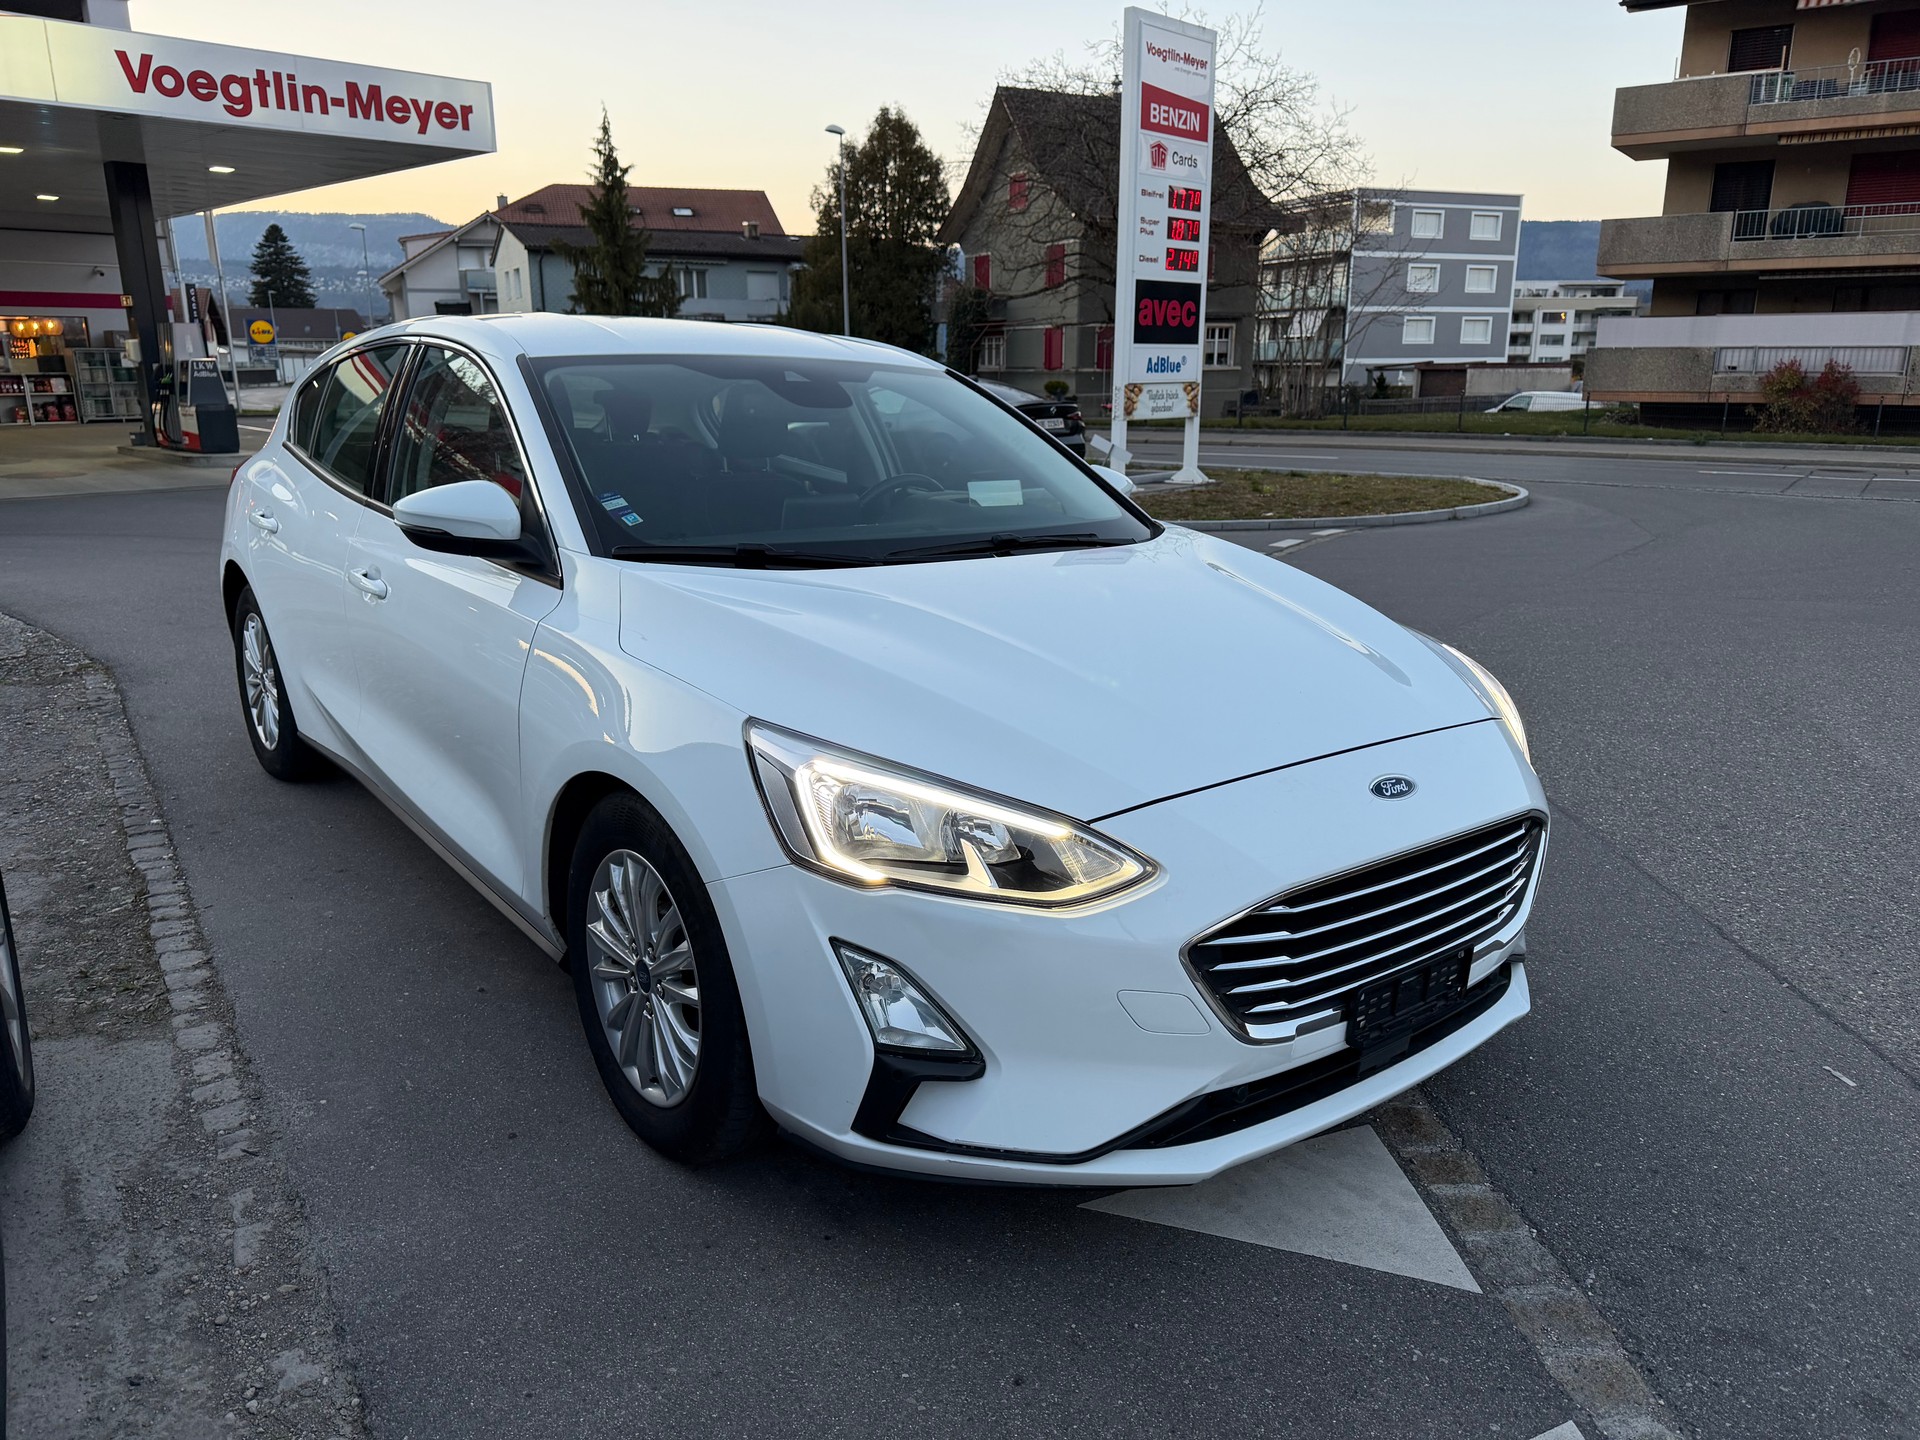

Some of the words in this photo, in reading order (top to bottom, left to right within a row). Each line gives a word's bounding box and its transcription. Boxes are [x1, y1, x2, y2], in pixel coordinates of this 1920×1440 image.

[1146, 40, 1208, 71] Voegtlin-Meyer
[114, 49, 474, 135] Voegtlin-Meyer
[1150, 102, 1200, 133] BENZIN
[1172, 151, 1198, 168] Cards
[1141, 188, 1165, 199] Bleifrei
[1140, 216, 1160, 227] Super
[1140, 227, 1155, 236] Plus
[1139, 254, 1159, 264] Diesel
[1138, 298, 1197, 328] avec
[193, 361, 215, 370] LKW
[1380, 779, 1409, 796] Ford
